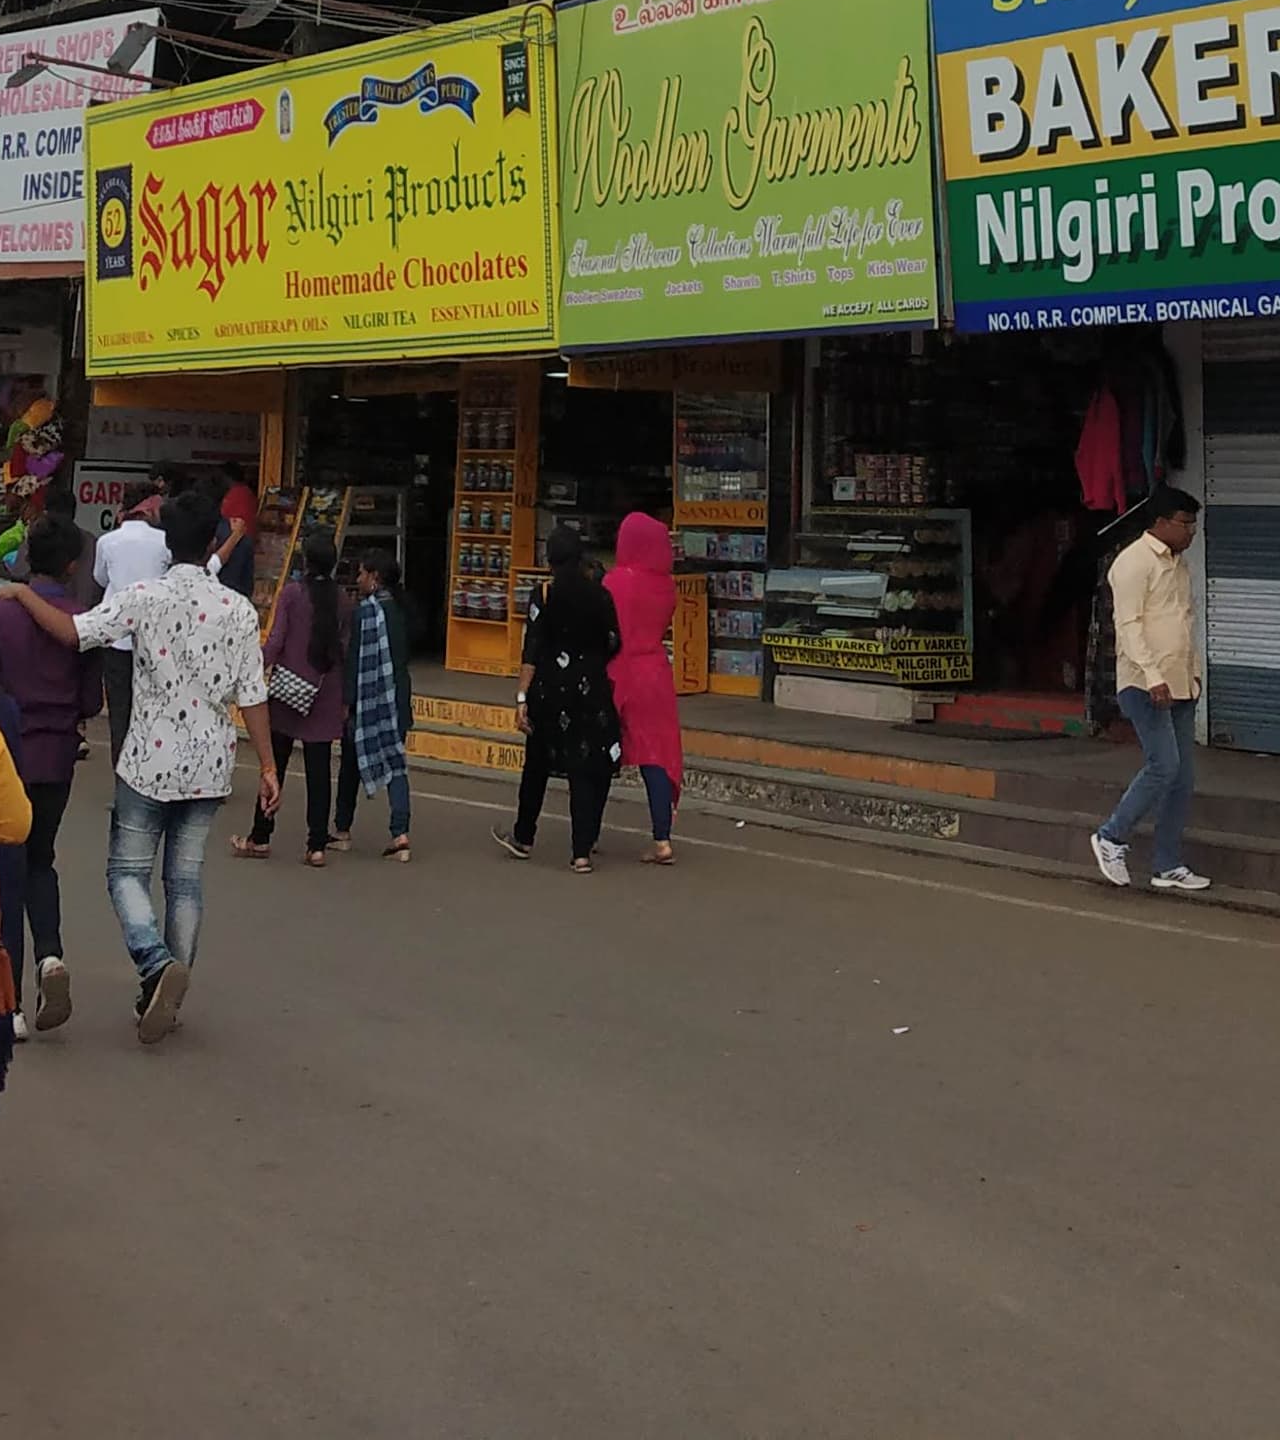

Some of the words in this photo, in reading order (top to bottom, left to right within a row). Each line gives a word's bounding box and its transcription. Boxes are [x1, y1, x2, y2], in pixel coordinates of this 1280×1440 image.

[55, 26, 115, 61] SHOPS
[504, 56, 526, 71] SINCE
[572, 67, 714, 213] Woollen
[720, 15, 922, 211] Garments
[1, 133, 30, 161] R.R.
[35, 125, 84, 157] COMP
[22, 169, 84, 201] INSIDE
[104, 208, 122, 238] 52
[137, 170, 279, 303] Sagar
[284, 168, 375, 247] Nilgiri
[384, 137, 528, 253] Products
[975, 171, 1160, 284] Nilgiri
[104, 255, 126, 270] YEARS
[284, 266, 397, 300] Homemade
[402, 251, 529, 290] Chocolates
[665, 279, 704, 297] Jackets
[723, 274, 761, 291] Shawls
[784, 268, 817, 287] Shirts
[826, 265, 855, 283] Tops
[866, 260, 893, 278] Kids
[896, 258, 928, 275] Wear
[166, 326, 200, 341] SPICES
[213, 318, 300, 338] AROMATHERAPY
[302, 316, 329, 332] OILS
[342, 313, 387, 329] NILGIRI
[388, 310, 417, 326] TEA
[430, 302, 509, 323] ESSENTIAL
[510, 298, 540, 317] OILS
[822, 304, 837, 318] WE
[837, 301, 873, 318] ACCEPT
[876, 299, 895, 313] ALL
[896, 297, 929, 312] CARDS
[1037, 308, 1068, 328] R.R.
[1155, 296, 1255, 322] BOTANICAL
[100, 420, 133, 436] ALL
[141, 422, 192, 439] YOUR
[678, 506, 743, 521] SANDAL
[746, 507, 765, 521] OI
[682, 596, 701, 690] SPICES
[764, 634, 793, 646] OOTY
[796, 635, 833, 649] FRESH
[834, 637, 882, 653] VARKEY
[890, 638, 921, 651] OOTY
[923, 638, 968, 651] VARKEY
[896, 656, 942, 670] NILGIRI
[946, 654, 970, 668] TEA
[901, 669, 947, 681] NILGIRI
[950, 667, 971, 679] OIL
